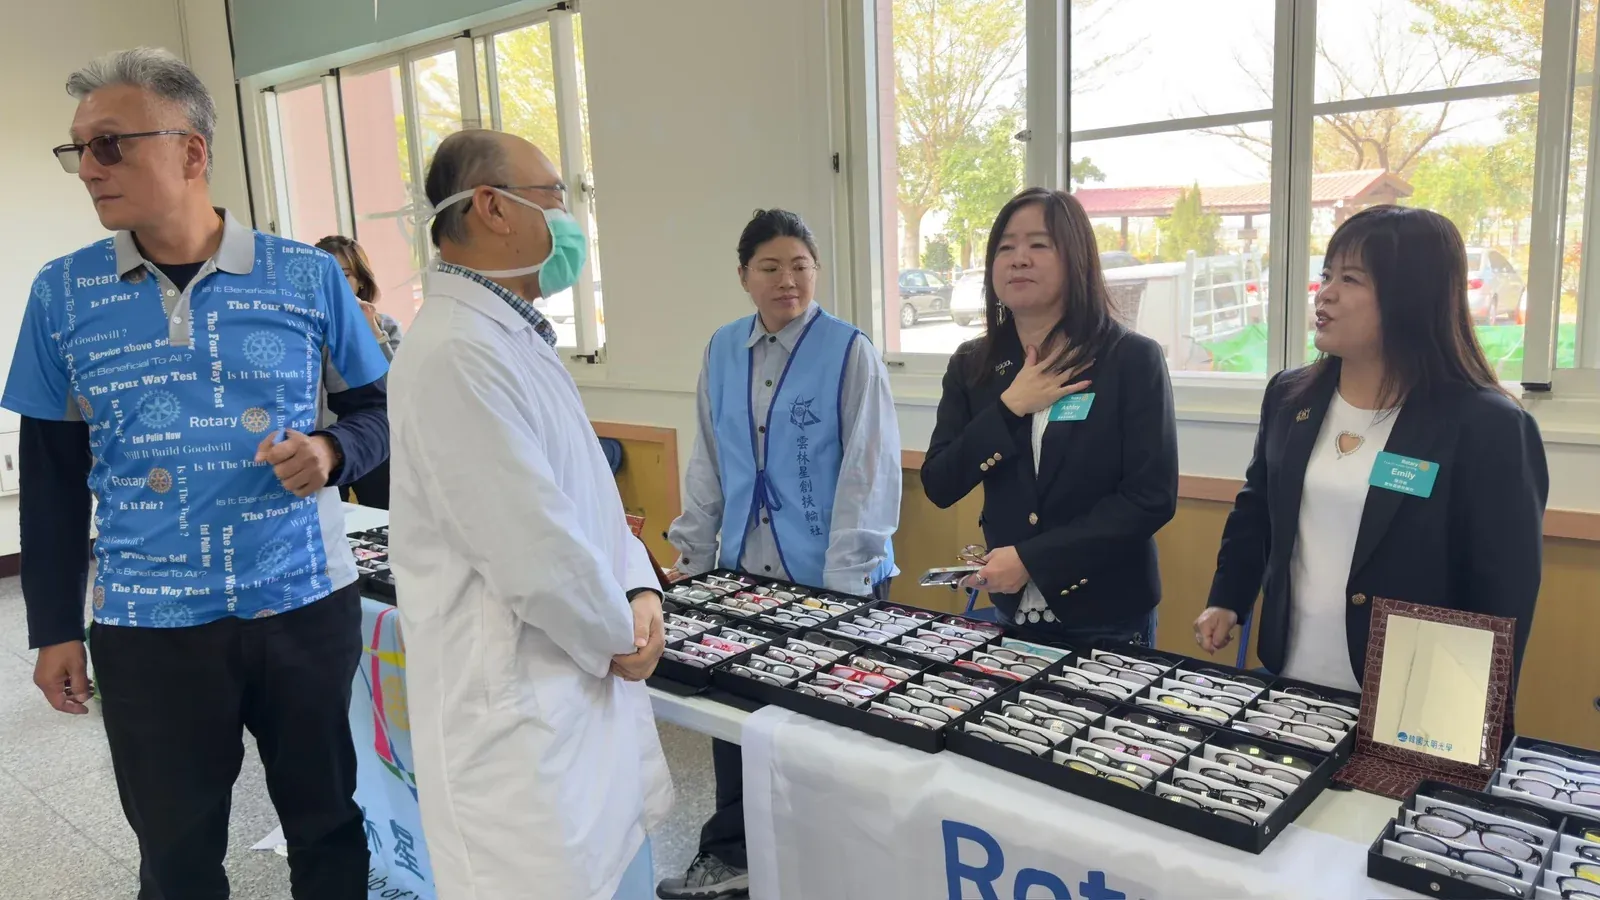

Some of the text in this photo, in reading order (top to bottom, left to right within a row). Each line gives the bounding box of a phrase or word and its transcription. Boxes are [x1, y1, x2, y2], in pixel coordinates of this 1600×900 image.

[224, 286, 276, 295] Beneficial
[280, 288, 292, 296] To
[294, 292, 306, 300] All
[226, 300, 325, 320] The Four Way Tes
[74, 330, 120, 346] Goodwill
[122, 328, 128, 337] ?
[124, 341, 152, 353] above
[155, 338, 170, 348] Sel
[151, 356, 166, 364] To
[168, 354, 182, 362] All
[184, 353, 192, 362] ?
[207, 311, 224, 408] The Four Way Test
[227, 370, 305, 380] Is It The Truth ?
[89, 372, 198, 396] The Four Way Test
[190, 416, 238, 428] Rotary
[132, 432, 182, 444] End Polio Now
[124, 442, 231, 460] Will It Build Goodwill
[176, 466, 186, 474] Is
[194, 463, 203, 471] Is
[207, 462, 216, 470] It
[218, 460, 238, 470] The
[1391, 468, 1416, 480] Emily
[112, 476, 147, 488] Rotary
[796, 435, 823, 537] 雲林星創扶輪社
[178, 487, 188, 504] The
[216, 498, 226, 506] Is
[120, 502, 128, 510] Is
[140, 501, 158, 510] Fair
[159, 501, 164, 510] ?
[242, 512, 264, 522] The
[266, 506, 290, 518] Four
[222, 525, 234, 546] The
[169, 554, 188, 563] Self
[224, 548, 235, 572] Four
[170, 570, 182, 578] To
[184, 570, 198, 578] All
[283, 568, 304, 578] Truth
[112, 583, 211, 598] The Four Way Test
[224, 574, 236, 595] Way
[302, 589, 330, 605] Service
[103, 617, 120, 626] Self
